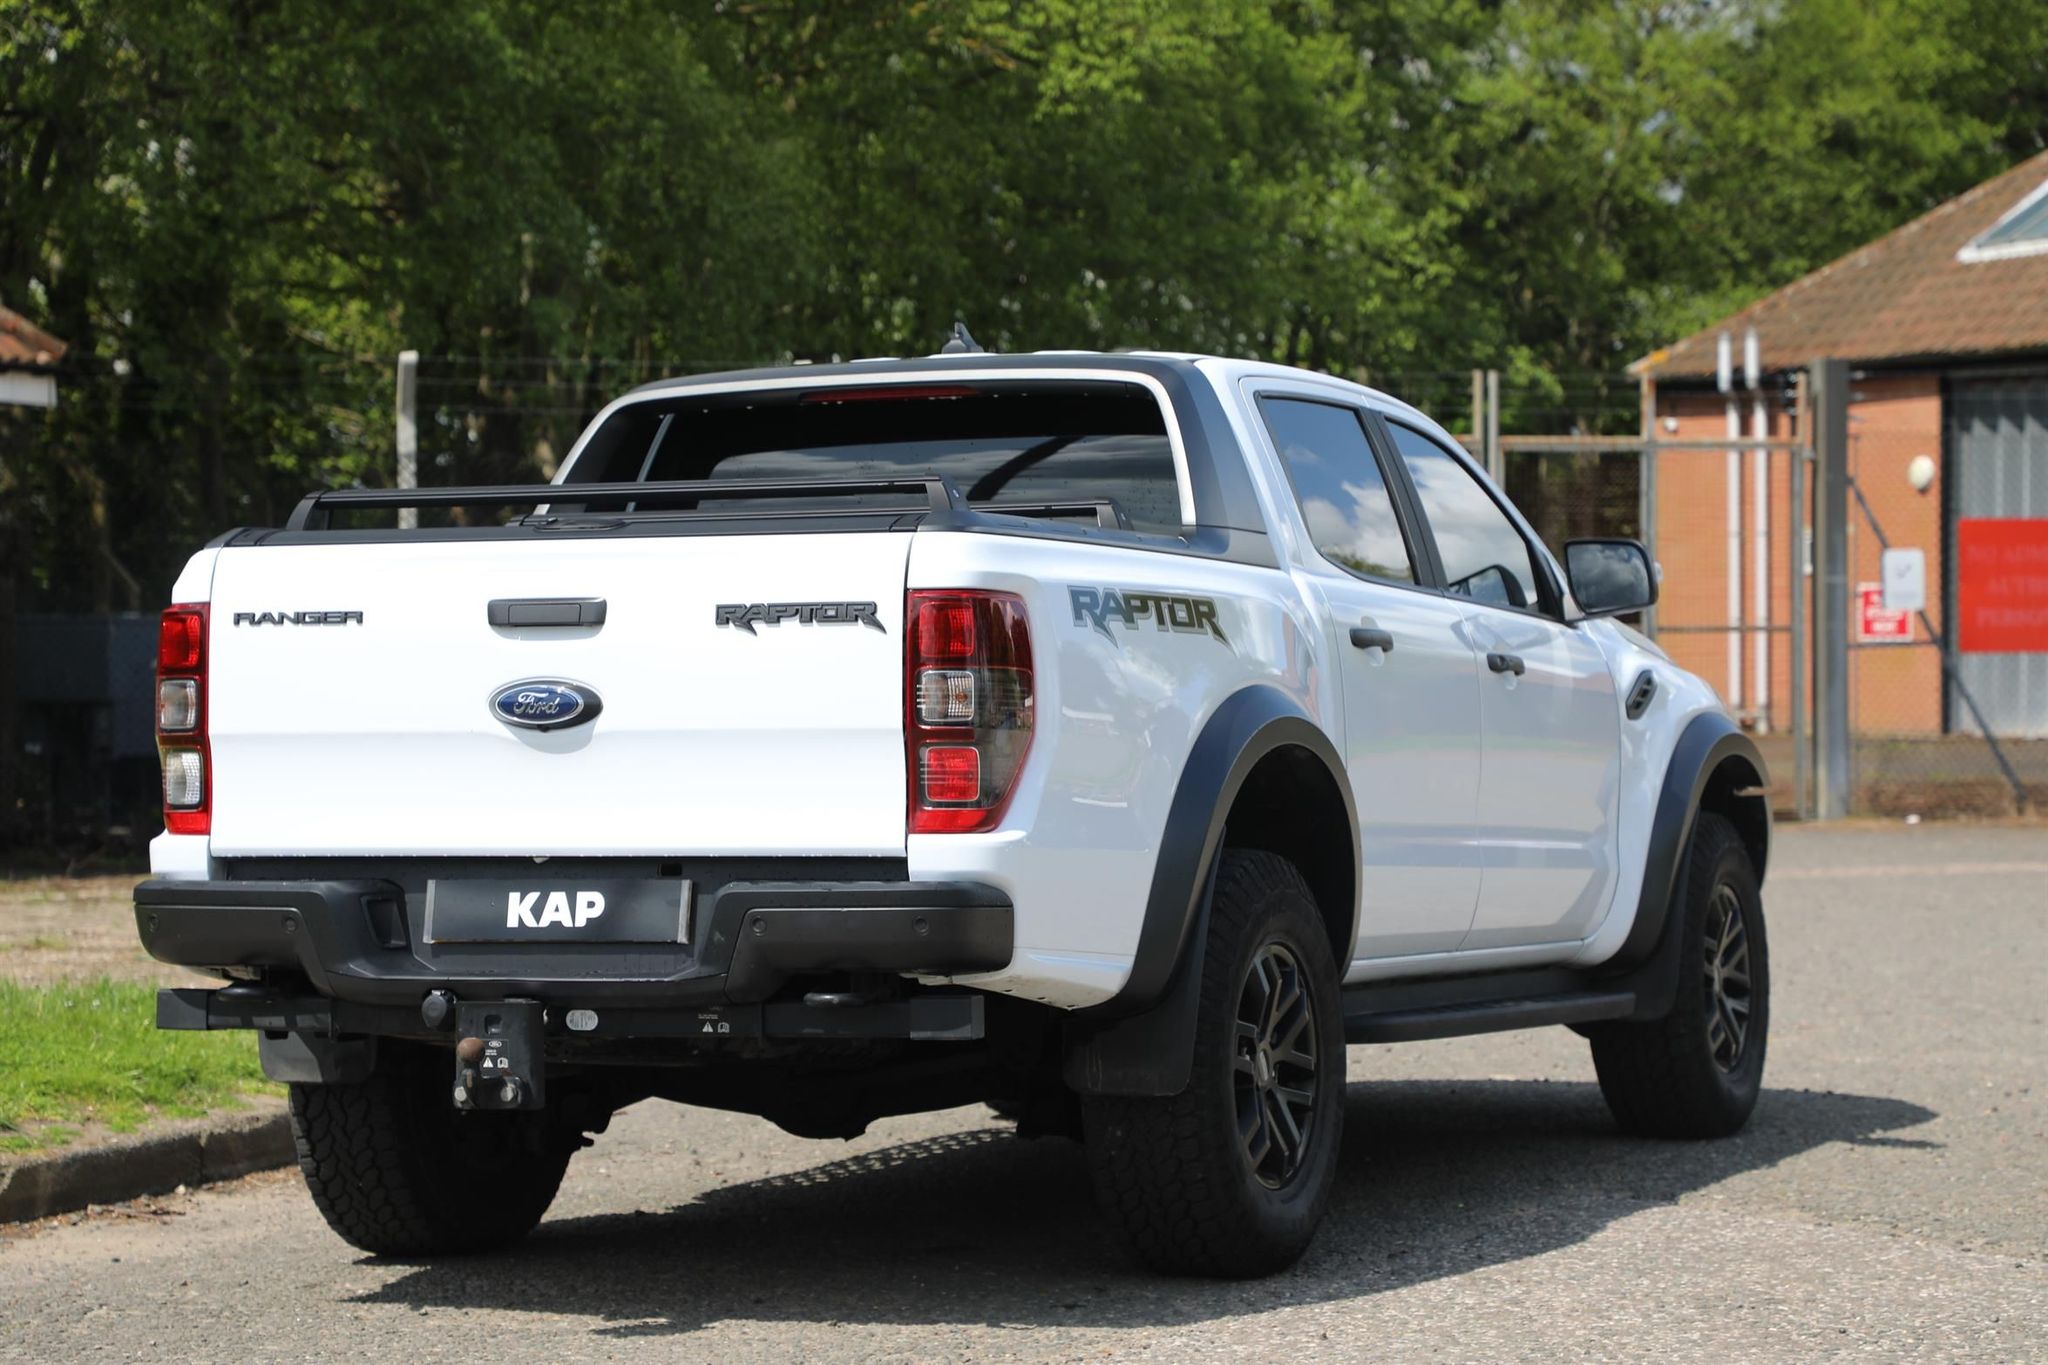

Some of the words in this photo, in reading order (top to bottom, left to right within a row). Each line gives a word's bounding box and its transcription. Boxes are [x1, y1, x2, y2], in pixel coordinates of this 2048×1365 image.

[233, 611, 363, 626] RANGER
[716, 601, 887, 636] RAPTOR
[1067, 585, 1238, 656] RAPTOR
[513, 692, 560, 714] Ford
[507, 891, 605, 928] KAP
